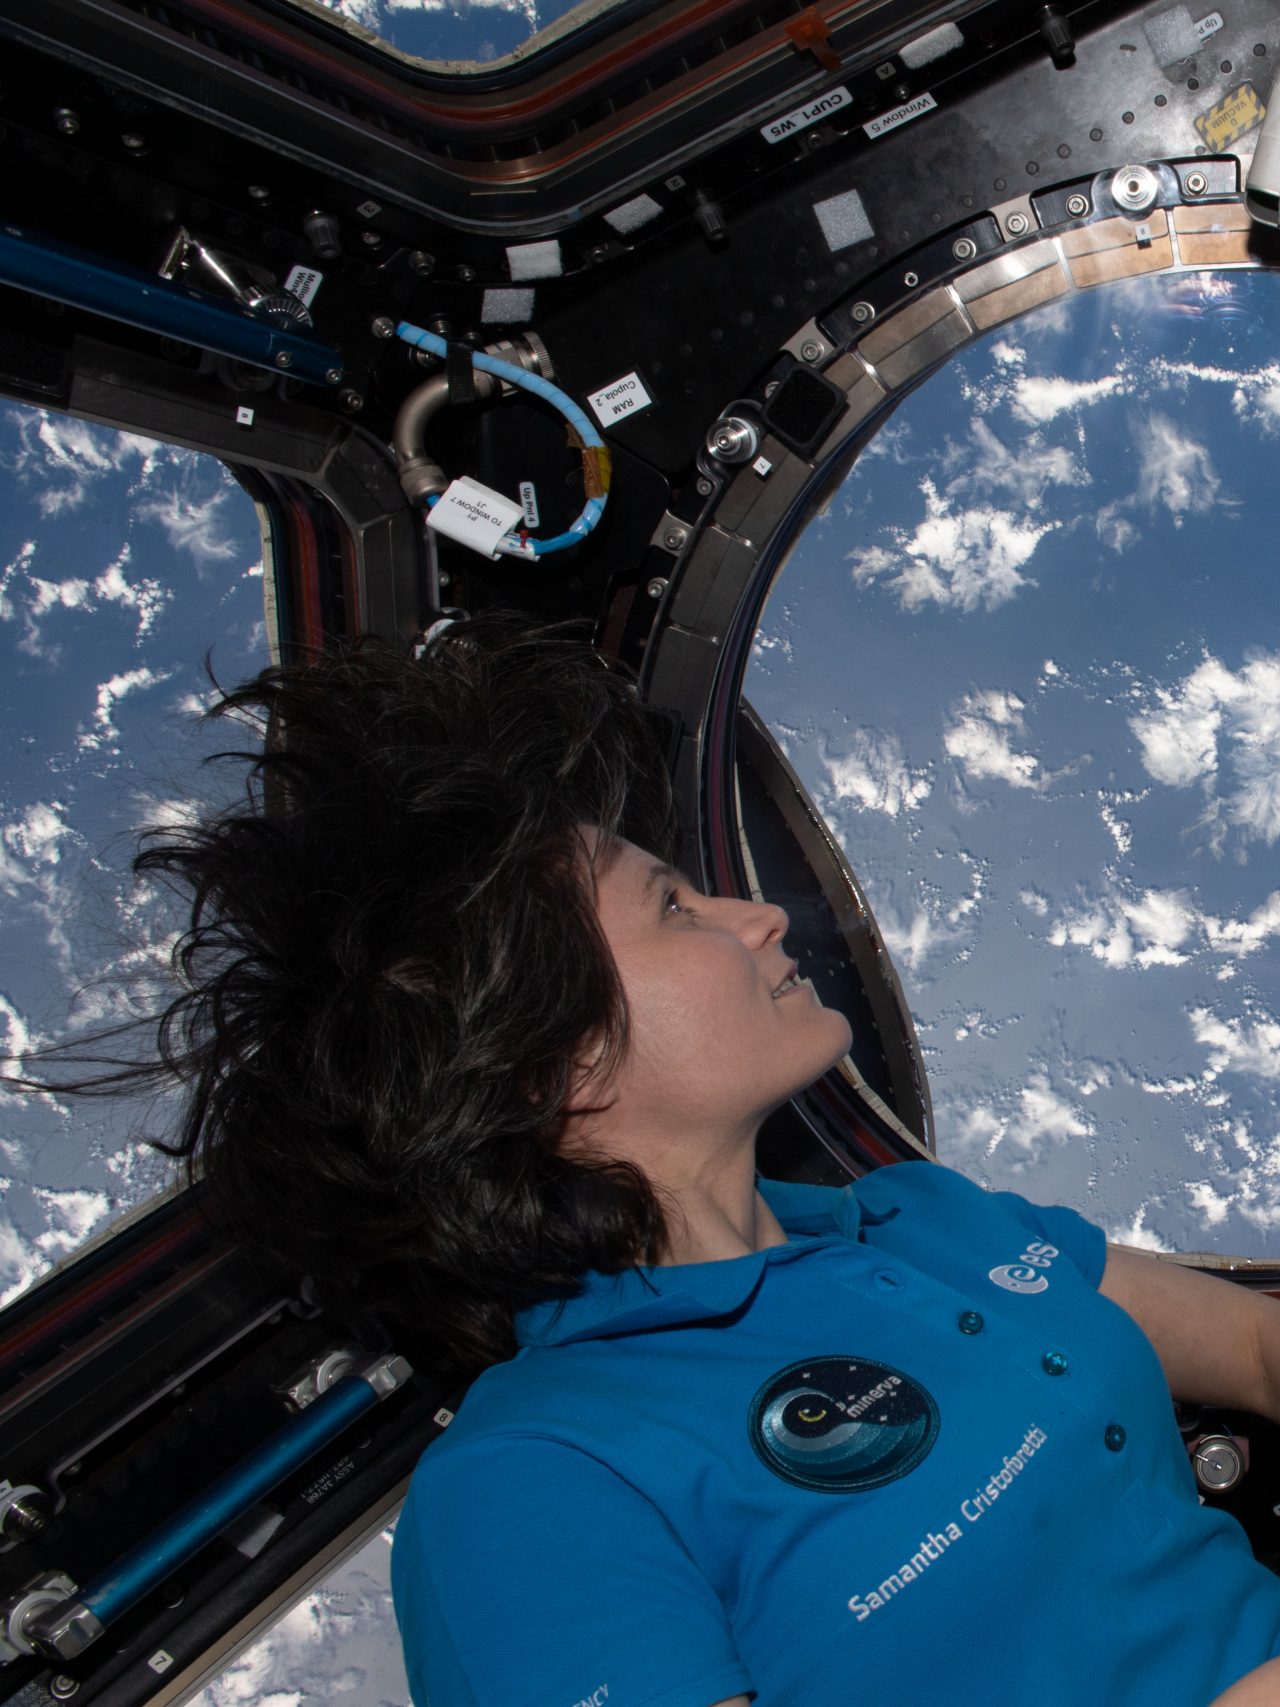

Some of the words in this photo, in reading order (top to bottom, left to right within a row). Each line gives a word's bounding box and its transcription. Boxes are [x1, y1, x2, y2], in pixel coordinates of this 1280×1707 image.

[771, 94, 843, 137] CUP1_W5
[883, 98, 930, 127] Window
[1211, 101, 1246, 129] VACUUM
[871, 123, 881, 133] 5
[299, 273, 316, 300] Mullio
[595, 380, 636, 407] Cupola_2
[612, 398, 634, 415] RAM
[523, 487, 531, 498] Up
[457, 499, 491, 522] WINDOW
[525, 499, 533, 513] Pnl
[491, 516, 503, 527] TO
[846, 1375, 902, 1419] minerva
[439, 1413, 448, 1422] 8
[847, 1521, 963, 1622] Samantha
[960, 1423, 1049, 1524] Cristoforetti
[154, 1655, 167, 1666] 7
